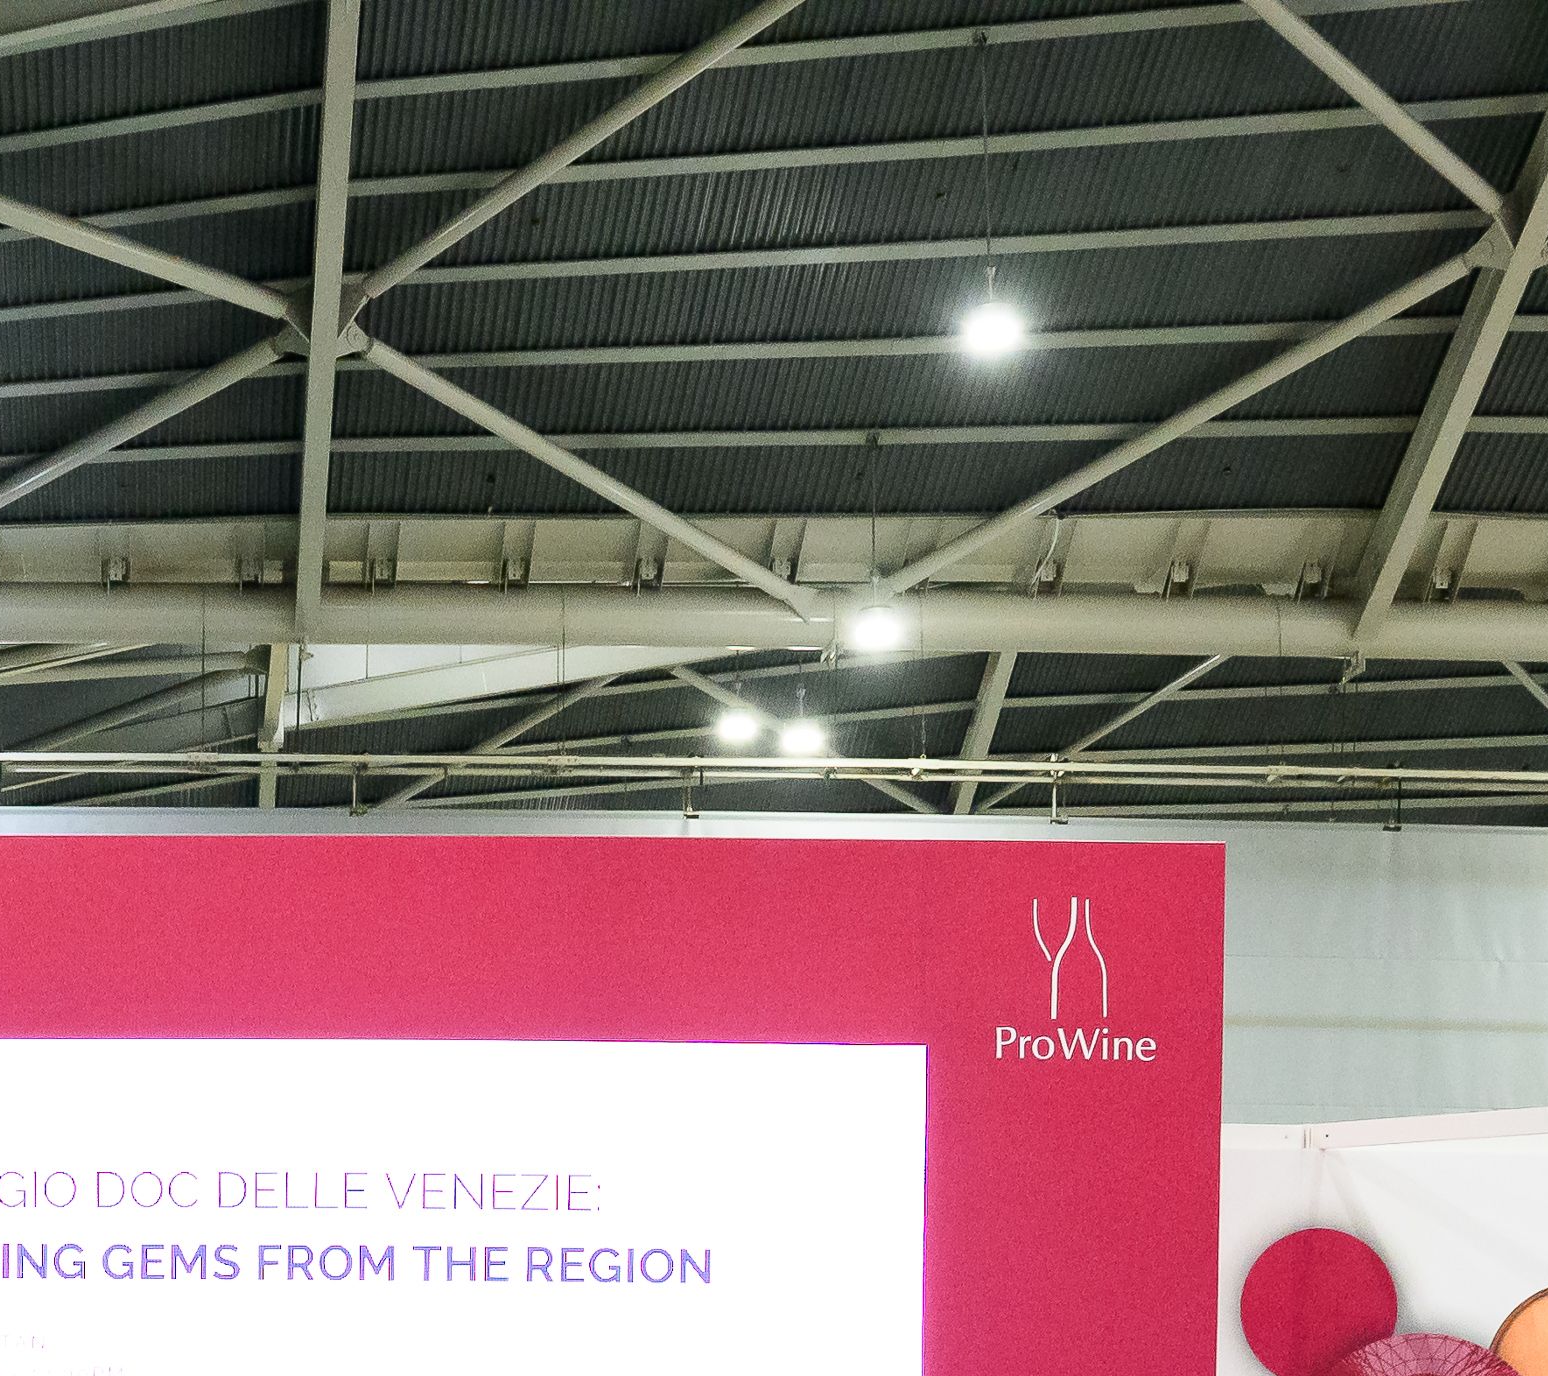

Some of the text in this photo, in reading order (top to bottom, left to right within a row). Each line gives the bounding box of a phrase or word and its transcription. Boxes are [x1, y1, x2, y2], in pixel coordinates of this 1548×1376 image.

[994, 1026, 1158, 1062] ProWine
[96, 1171, 199, 1208] DOC
[218, 1171, 368, 1209] DELLE
[385, 1173, 601, 1211] VENEZIE:
[102, 1244, 241, 1280] GEMS
[257, 1245, 395, 1281] FROM
[412, 1246, 509, 1282] THE
[526, 1247, 711, 1284] REGION
